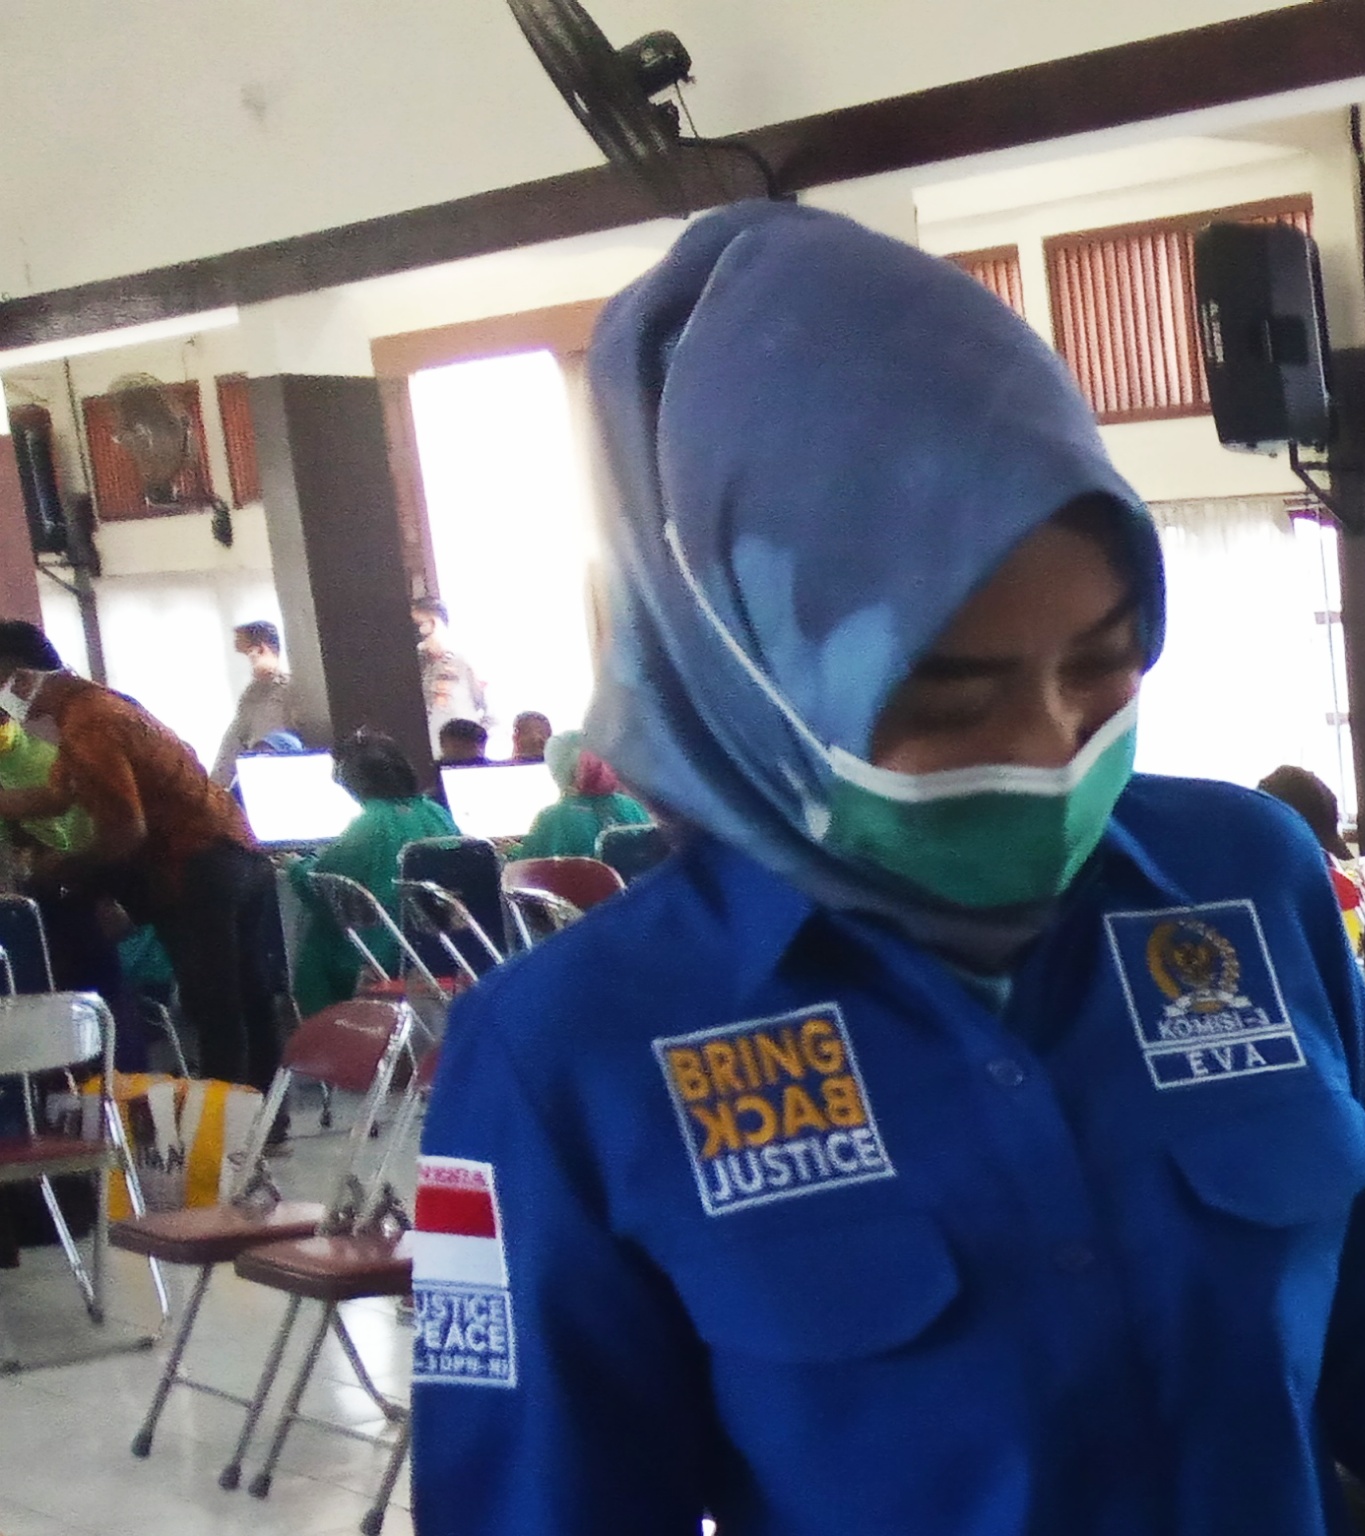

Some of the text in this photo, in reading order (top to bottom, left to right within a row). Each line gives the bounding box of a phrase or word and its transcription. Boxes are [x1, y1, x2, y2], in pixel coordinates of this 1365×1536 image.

[668, 1019, 844, 1101] BRING
[1185, 1043, 1267, 1077] EVA
[706, 1128, 883, 1201] JUSTICE
